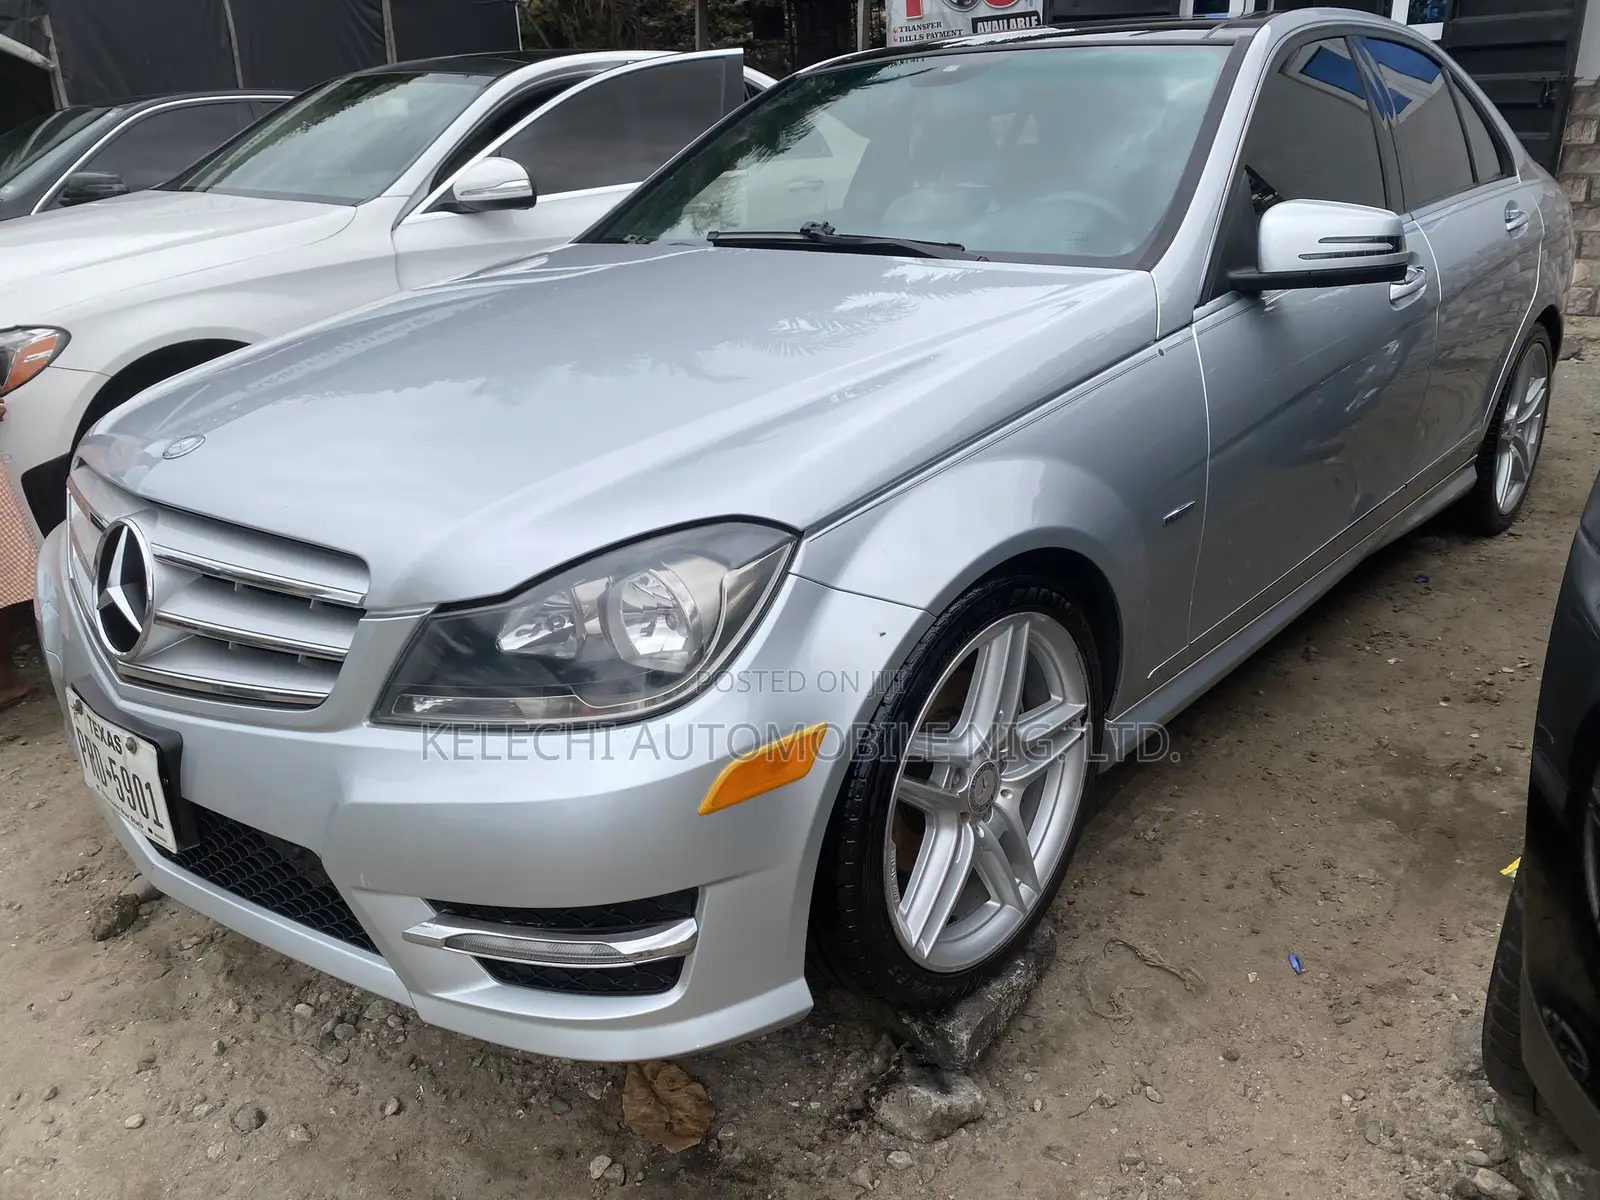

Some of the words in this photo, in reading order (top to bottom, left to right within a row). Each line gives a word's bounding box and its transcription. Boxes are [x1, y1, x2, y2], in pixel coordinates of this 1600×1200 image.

[899, 21, 942, 33] TRANSFER
[899, 33, 925, 43] BILLS
[926, 29, 964, 40] PAYMENT
[86, 714, 123, 755] TEXAS
